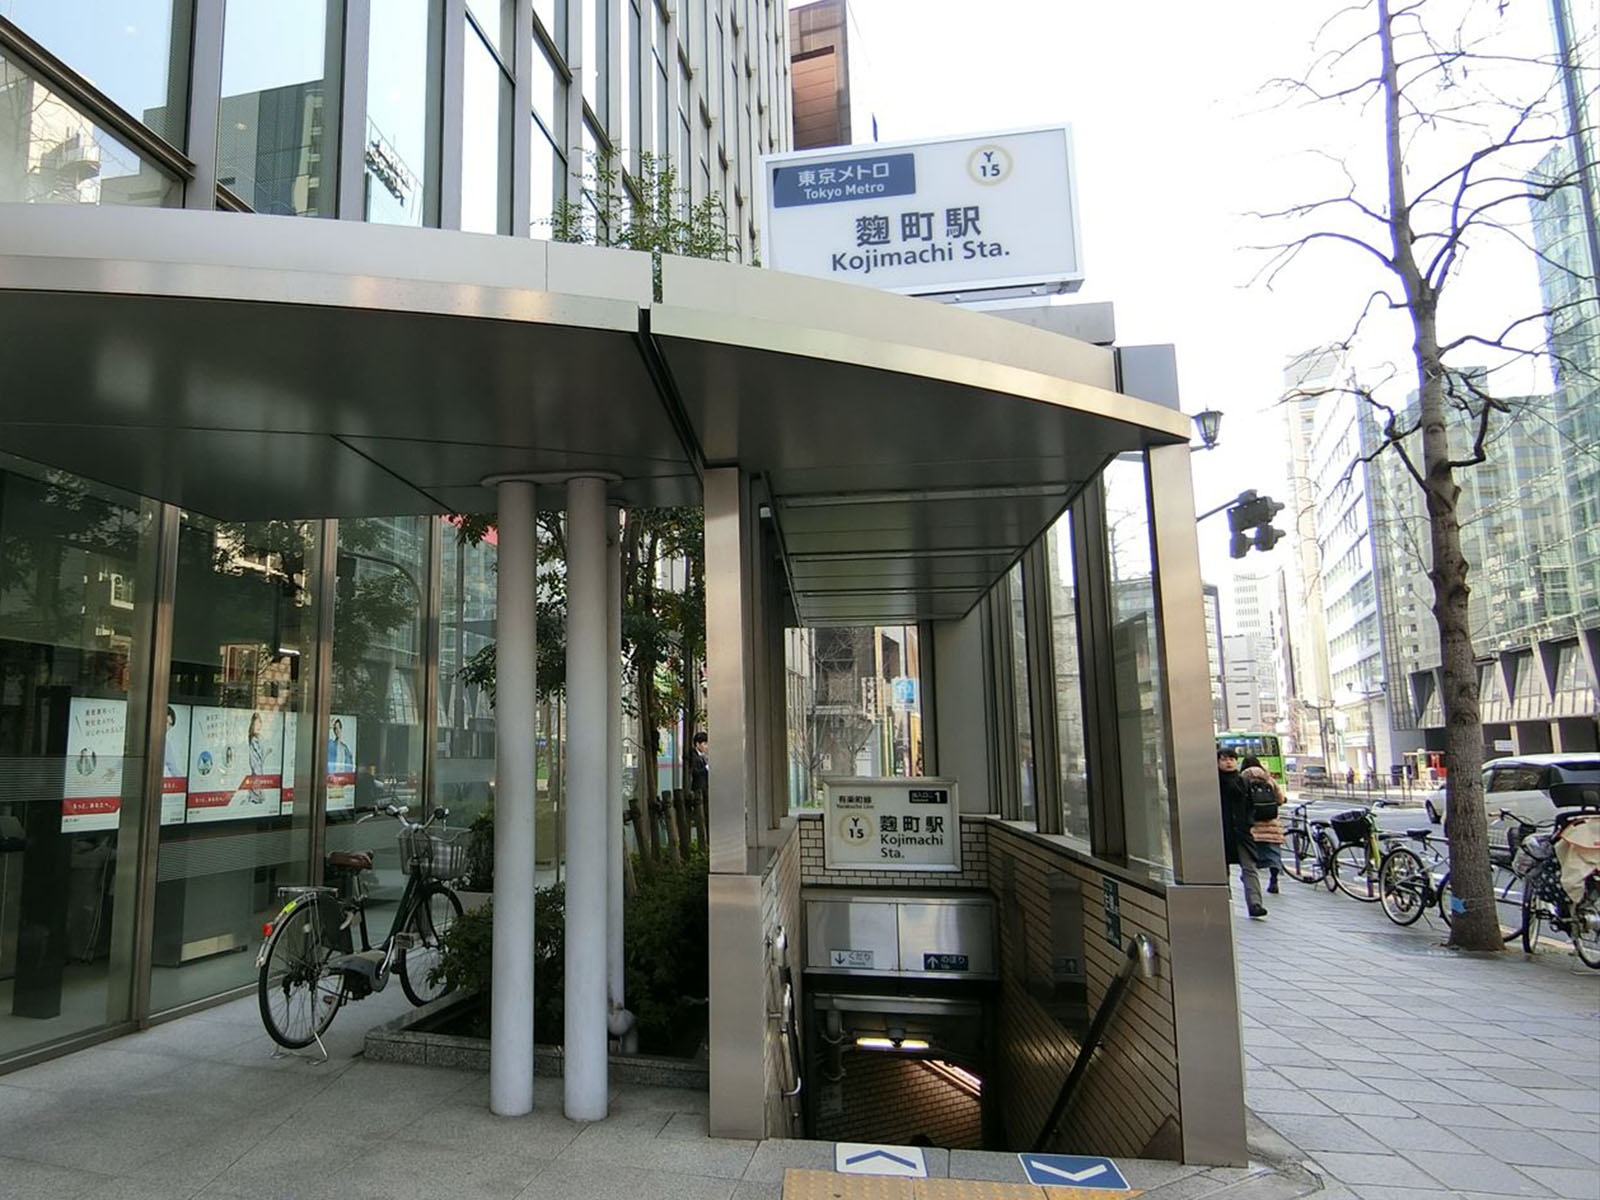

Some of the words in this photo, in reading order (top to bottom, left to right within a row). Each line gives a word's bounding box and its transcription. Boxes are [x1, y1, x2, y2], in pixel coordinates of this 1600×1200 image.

[984, 151, 993, 163] Y
[798, 162, 889, 187] 東京メトロ
[980, 164, 1000, 178] 15
[804, 185, 842, 201] Tokyo
[845, 181, 885, 197] Metro
[831, 242, 953, 274] Kojimachi
[963, 239, 1011, 261] Sta.
[934, 792, 941, 803] 1
[852, 817, 859, 827] Y
[849, 828, 864, 839] 15
[880, 834, 944, 847] Kojimachi
[881, 847, 905, 859] Sta.
